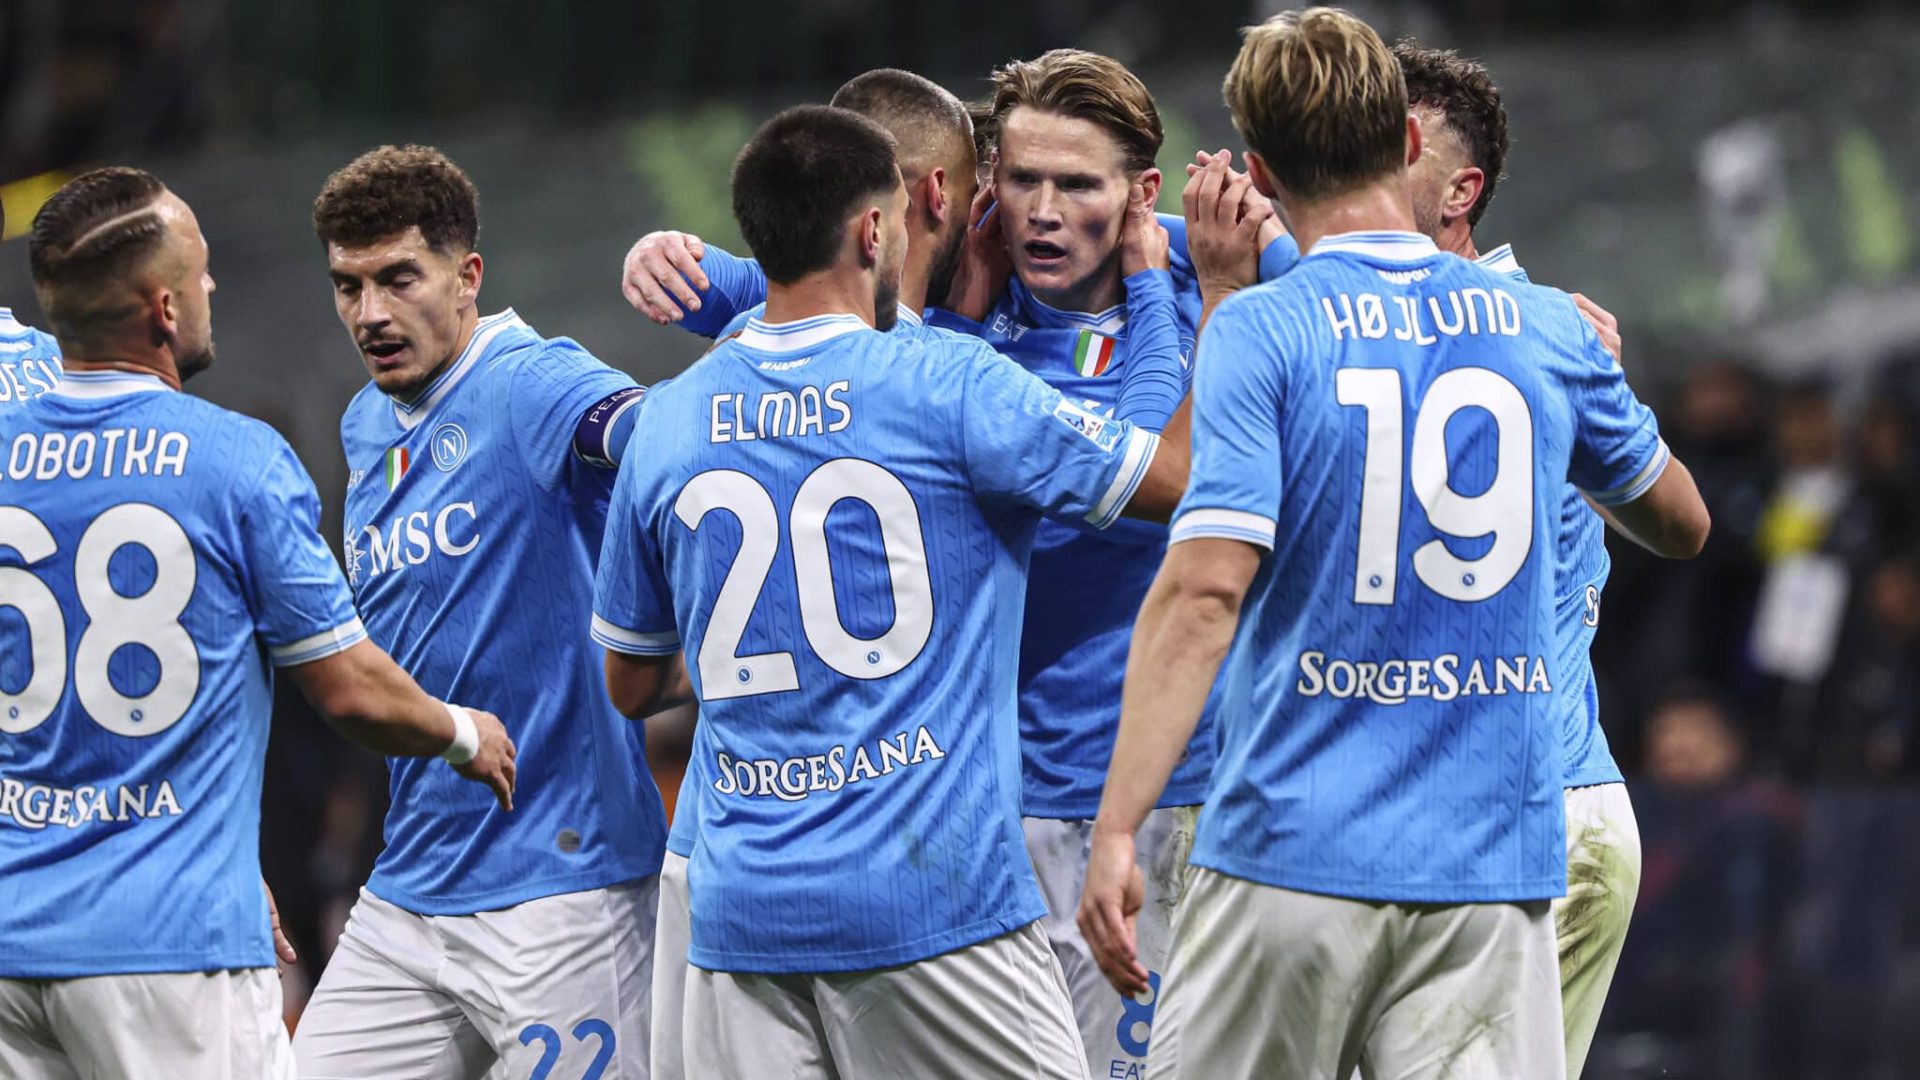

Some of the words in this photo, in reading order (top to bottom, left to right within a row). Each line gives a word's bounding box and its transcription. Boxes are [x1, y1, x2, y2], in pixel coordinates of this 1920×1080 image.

[1323, 288, 1521, 347] HØJLUND
[710, 379, 851, 444] ELMAS
[0, 428, 190, 481] OBOTKA
[1336, 366, 1534, 606] 19
[363, 500, 480, 577] MSC
[673, 456, 934, 701] 20
[518, 1018, 616, 1080] 22
[1116, 970, 1161, 1057] 8
